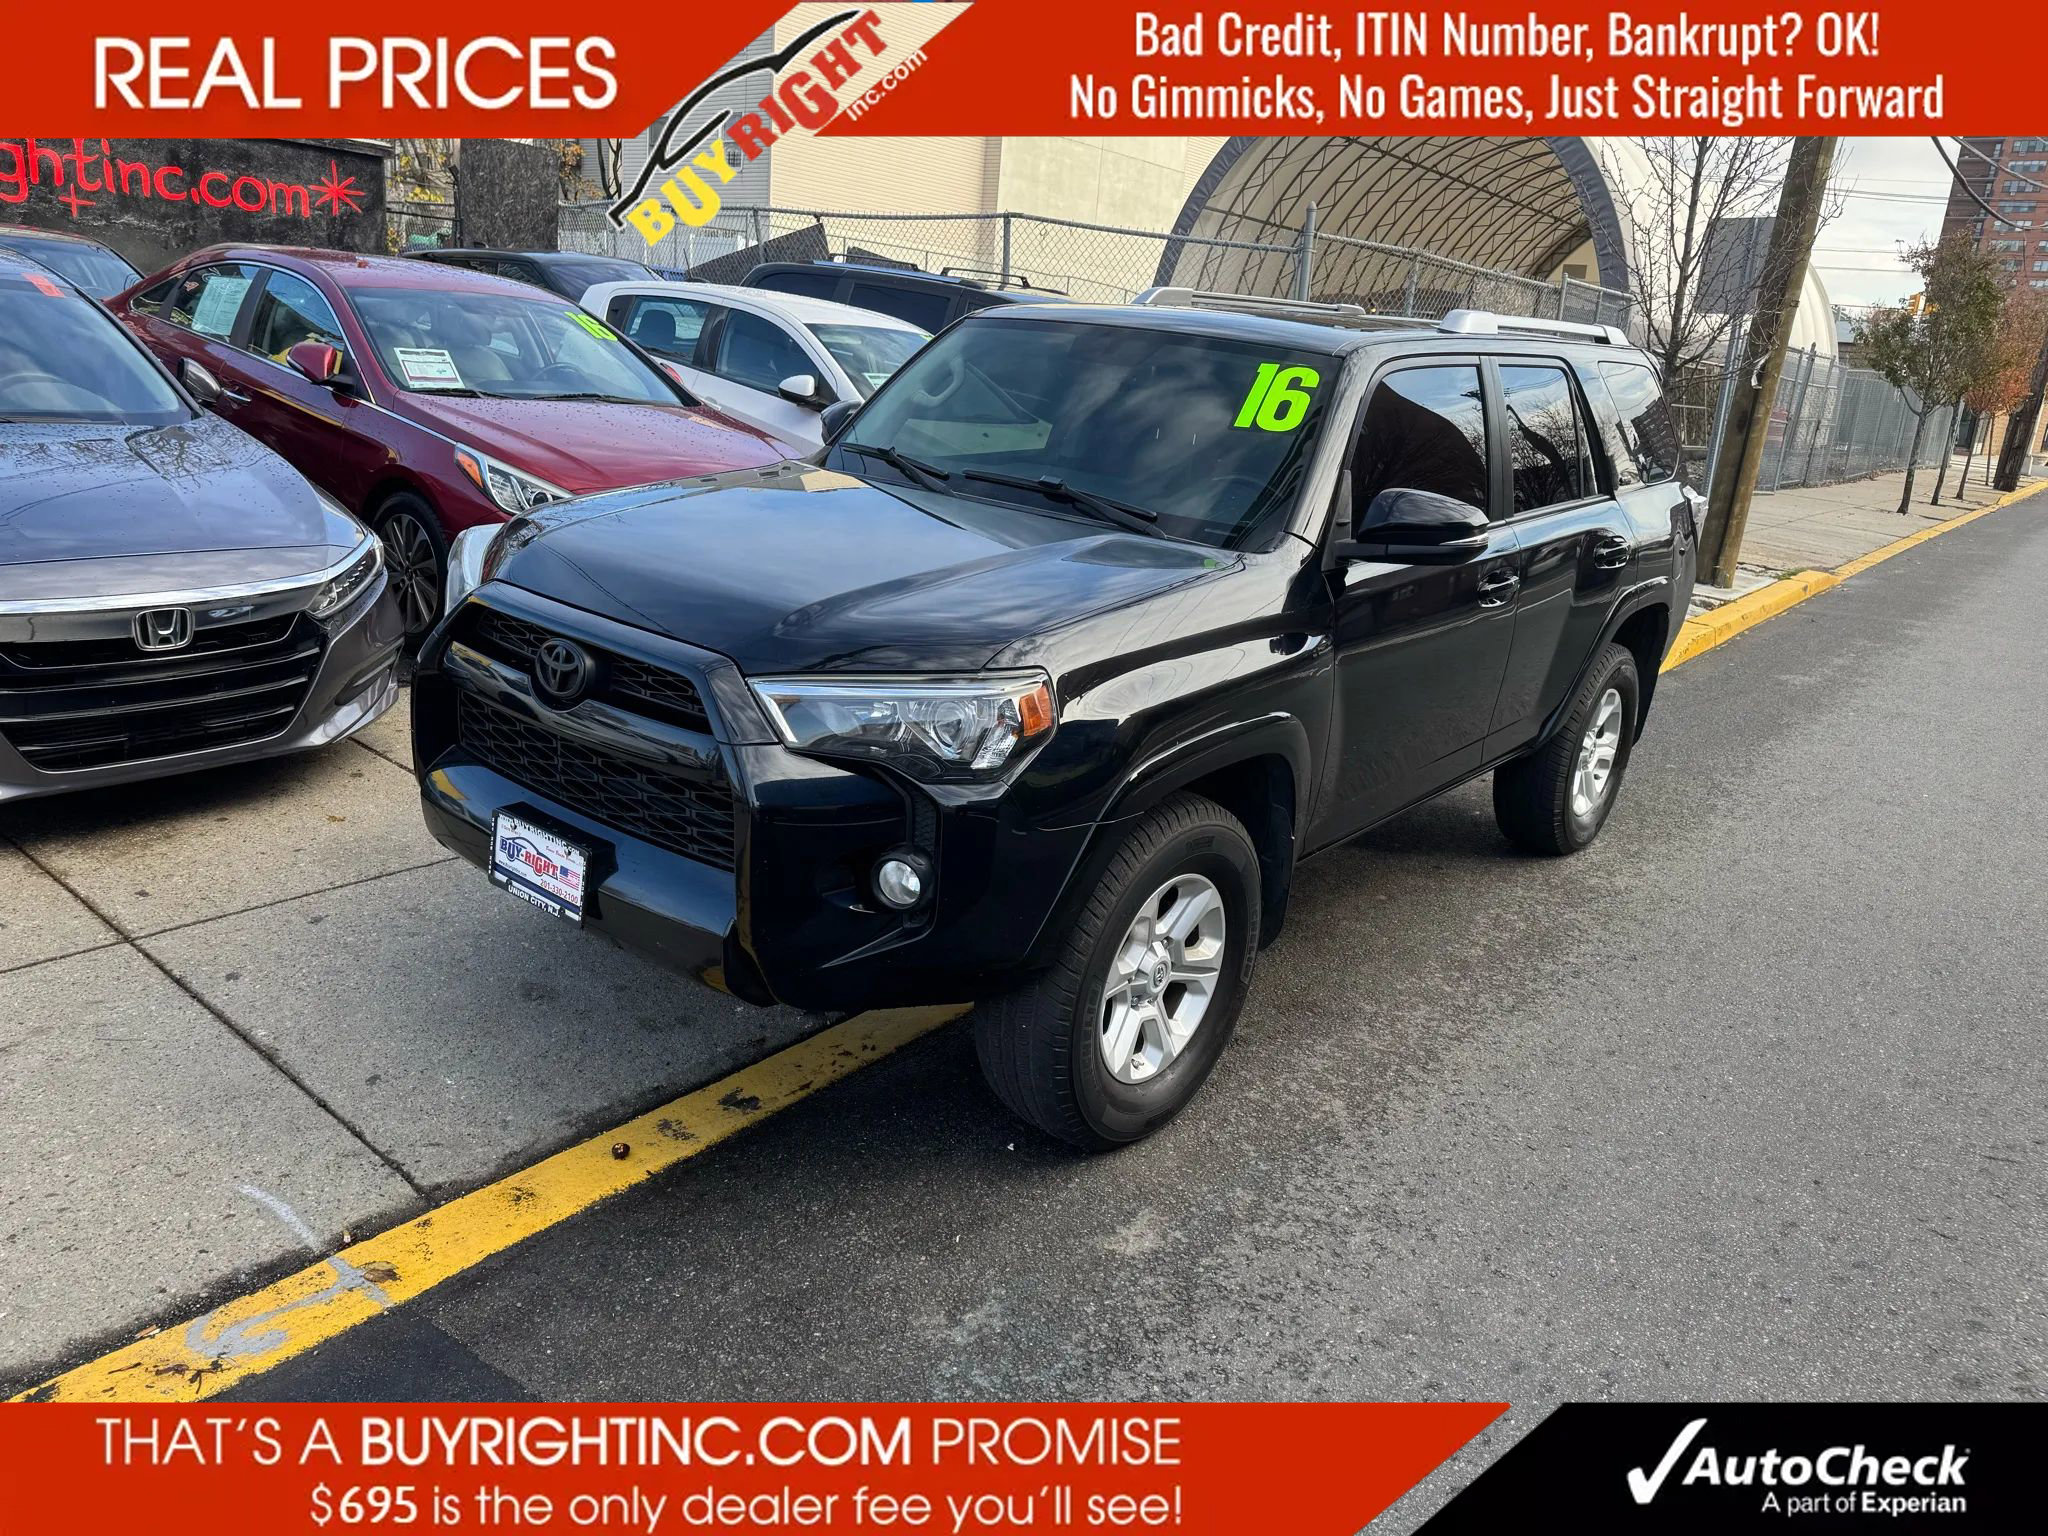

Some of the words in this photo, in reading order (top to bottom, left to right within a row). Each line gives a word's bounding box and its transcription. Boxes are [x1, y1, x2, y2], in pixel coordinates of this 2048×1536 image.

[1234, 363, 1320, 432] 16
[508, 884, 529, 902] UNION
[530, 894, 547, 912] CITY,
[540, 878, 579, 904] 201-330-2100
